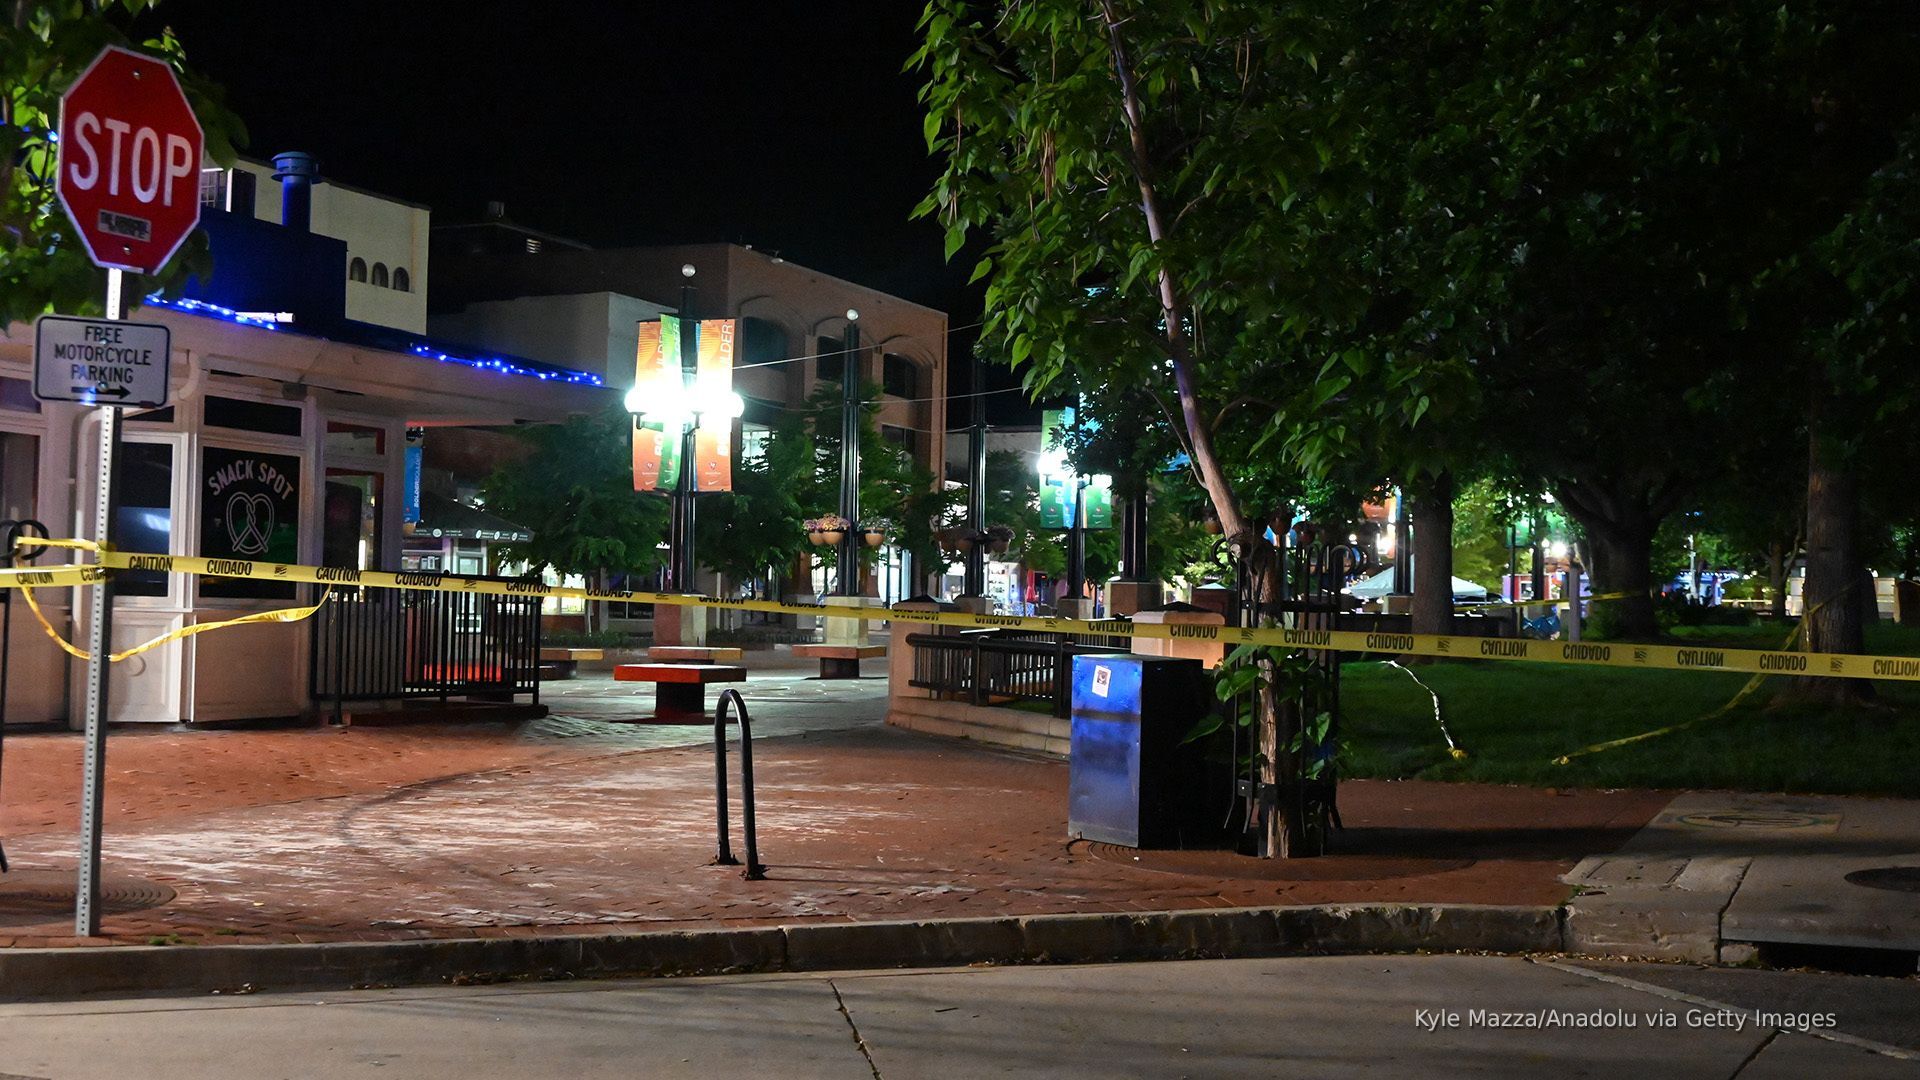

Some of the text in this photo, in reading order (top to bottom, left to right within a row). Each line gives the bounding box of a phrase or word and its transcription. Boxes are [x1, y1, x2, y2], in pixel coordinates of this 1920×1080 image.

[70, 112, 193, 207] STOP
[85, 326, 123, 343] FREE
[54, 344, 152, 366] MOTORCYCLE
[71, 364, 134, 384] PARKING
[208, 460, 294, 500] SNACK SPOT
[16, 571, 55, 585] CAUTION
[129, 556, 174, 571] CAUTION
[206, 559, 252, 576] CUIDADO
[316, 567, 362, 582] CAUTION
[395, 573, 442, 587] CUIDADO
[506, 582, 551, 594] CAUTION
